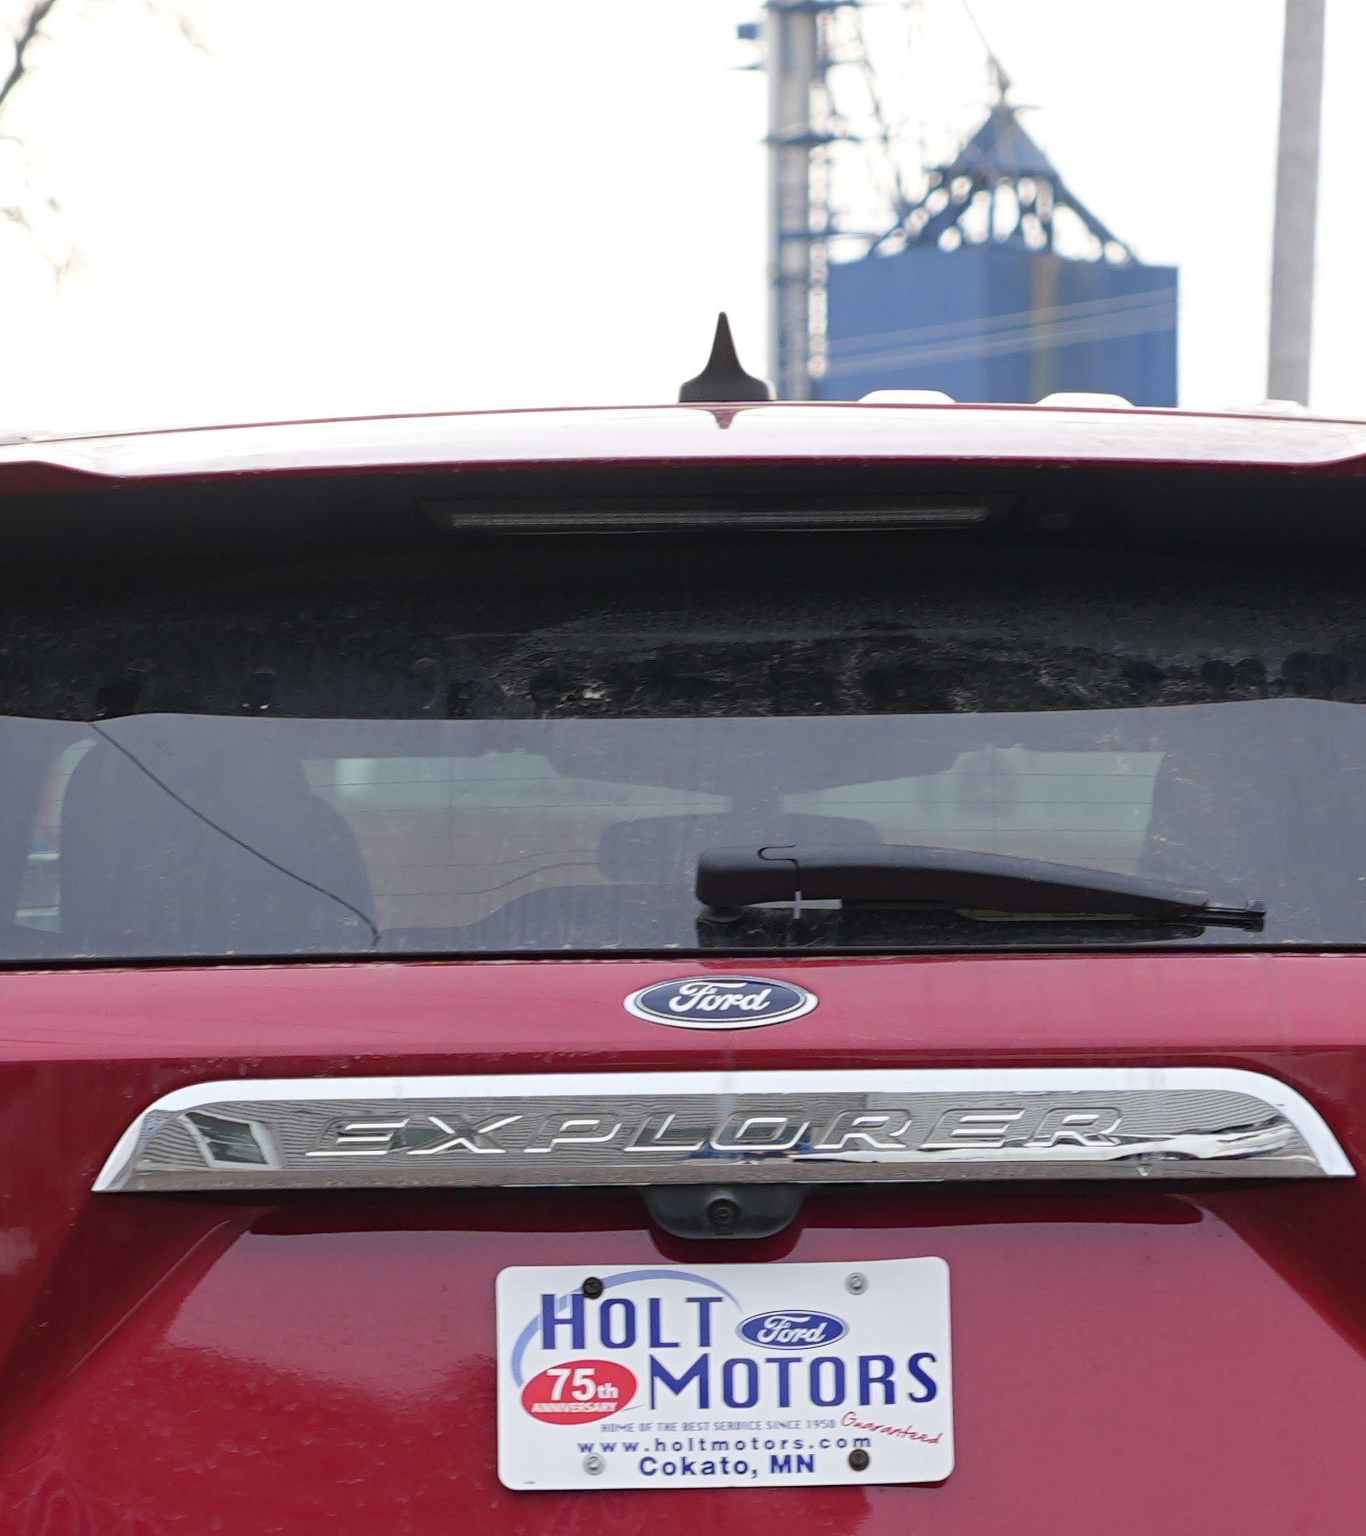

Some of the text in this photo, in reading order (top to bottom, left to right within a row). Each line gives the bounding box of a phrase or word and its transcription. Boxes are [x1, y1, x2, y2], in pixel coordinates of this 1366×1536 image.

[668, 981, 773, 1013] Ford
[304, 1105, 1123, 1156] EXPLORER
[540, 1292, 723, 1351] HOLT
[756, 1313, 827, 1344] Ford
[545, 1367, 620, 1402] 75th
[648, 1351, 938, 1412] MOTORS
[530, 1401, 619, 1413] ANNIVERSARY
[600, 1422, 636, 1433] HOME
[638, 1422, 653, 1433] OF
[657, 1421, 678, 1432] THE
[681, 1421, 710, 1432] BEST
[713, 1420, 762, 1431] SERVICE
[765, 1419, 801, 1430] SINCE
[840, 1411, 944, 1445] Guaranteed
[577, 1436, 872, 1454] www.holtmotors.com
[639, 1453, 815, 1479] Cokato, MN
